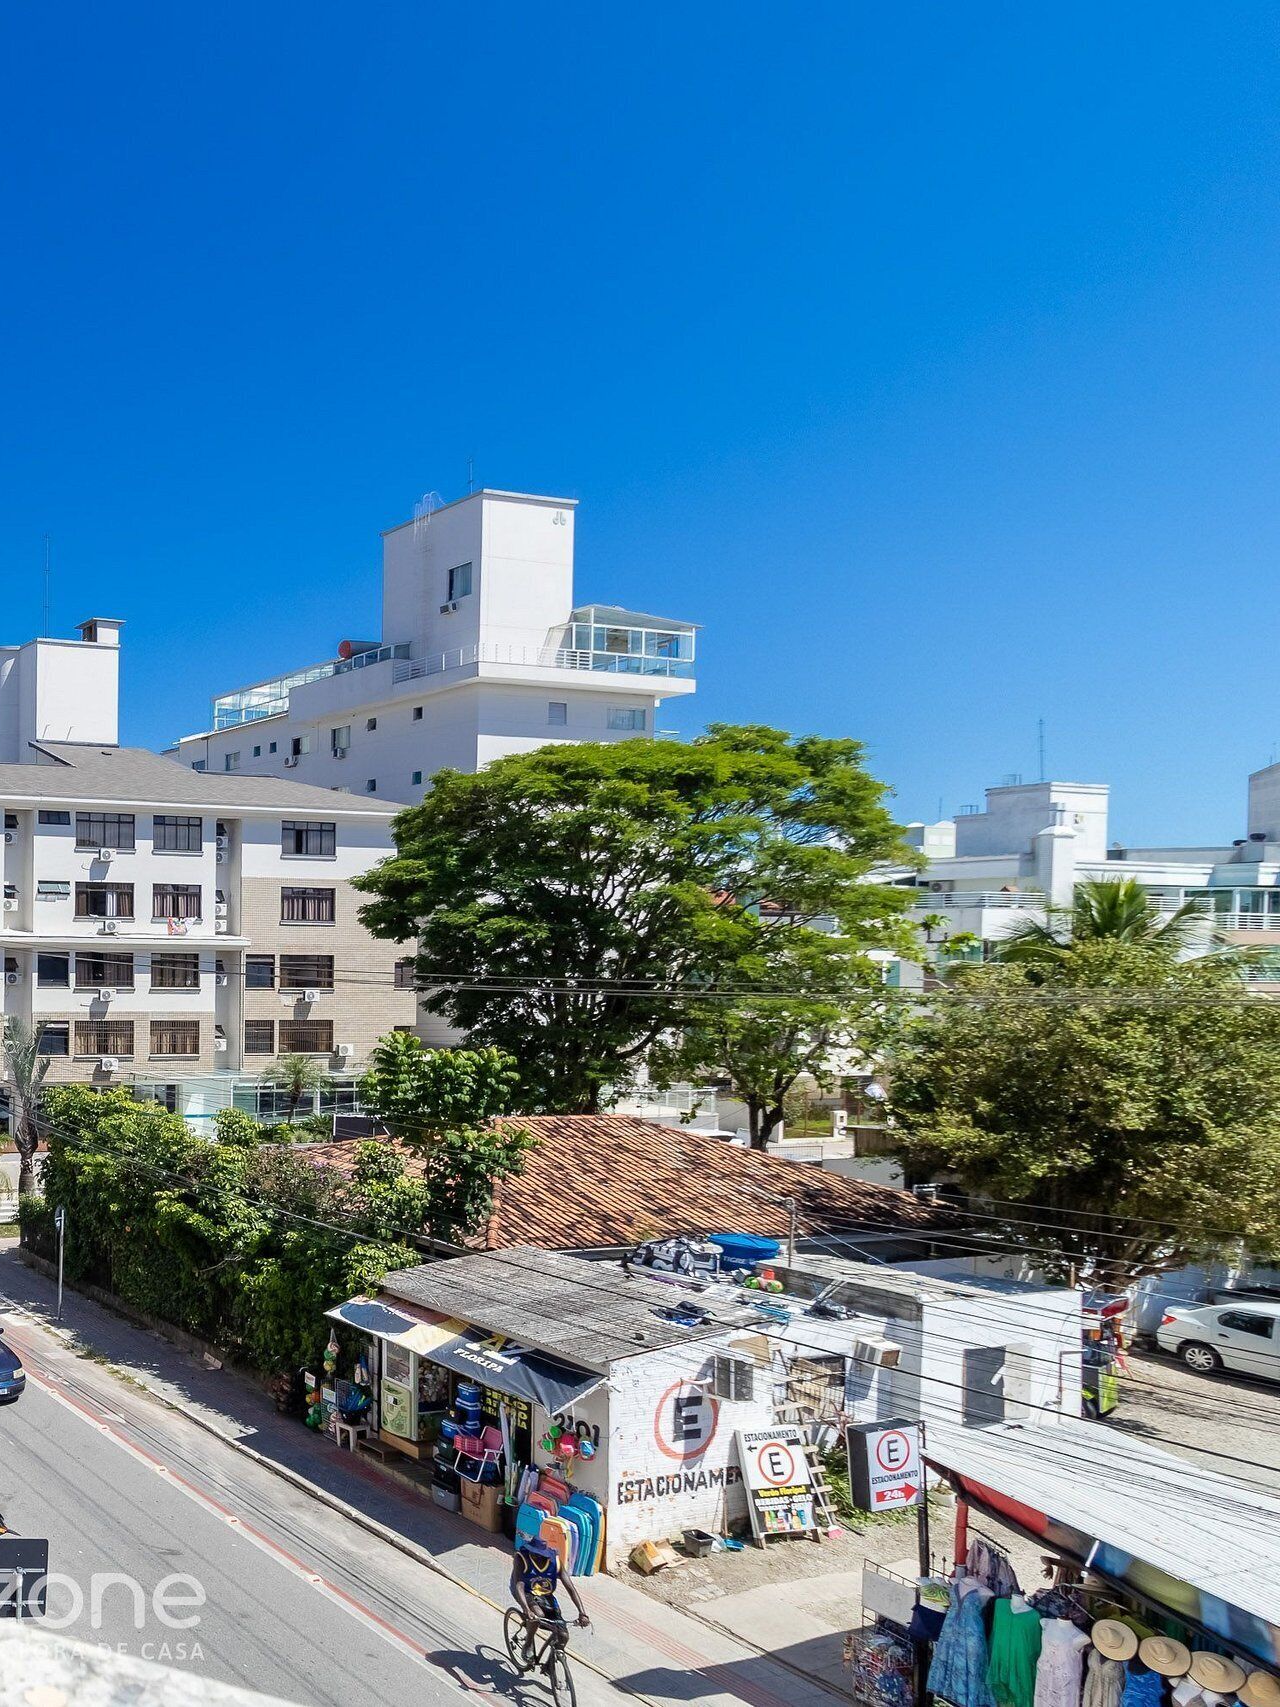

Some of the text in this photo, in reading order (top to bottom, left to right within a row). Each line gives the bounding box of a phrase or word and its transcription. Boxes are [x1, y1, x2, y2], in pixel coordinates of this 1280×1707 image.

[452, 1348, 505, 1373] FLORIPA
[672, 1395, 703, 1442] E
[744, 1429, 797, 1442] ESTACIONAMENTO
[887, 1439, 900, 1463] E
[768, 1452, 785, 1476] E
[871, 1469, 918, 1484] ESTACIONAMENTO
[883, 1489, 905, 1500] 24h
